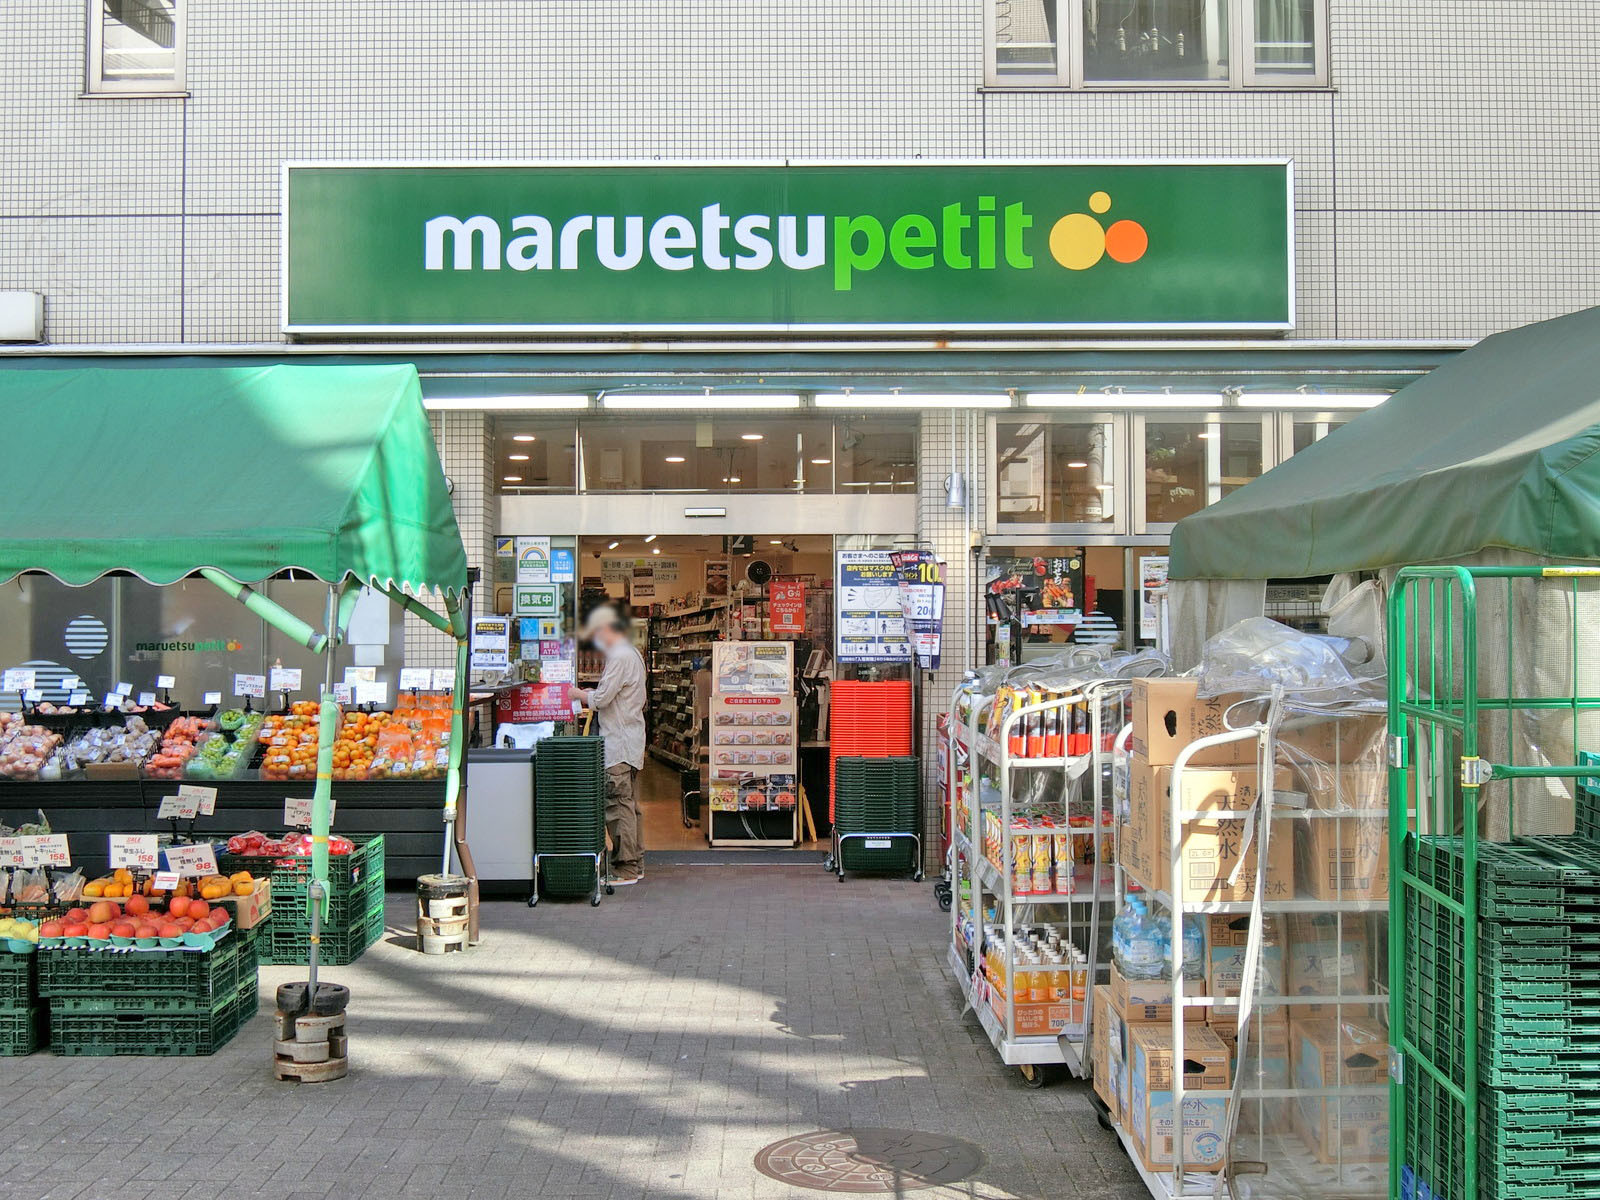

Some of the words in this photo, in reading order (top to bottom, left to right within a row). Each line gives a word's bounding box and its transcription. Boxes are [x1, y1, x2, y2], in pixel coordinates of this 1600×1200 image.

[424, 203, 826, 271] maruetsu
[833, 195, 1034, 291] petit
[1052, 558, 1063, 585] おせち
[520, 594, 552, 605] 換気中
[136, 641, 195, 652] maruetsu
[1214, 793, 1239, 860] 天然水
[138, 854, 154, 862] 158
[195, 862, 212, 871] 98
